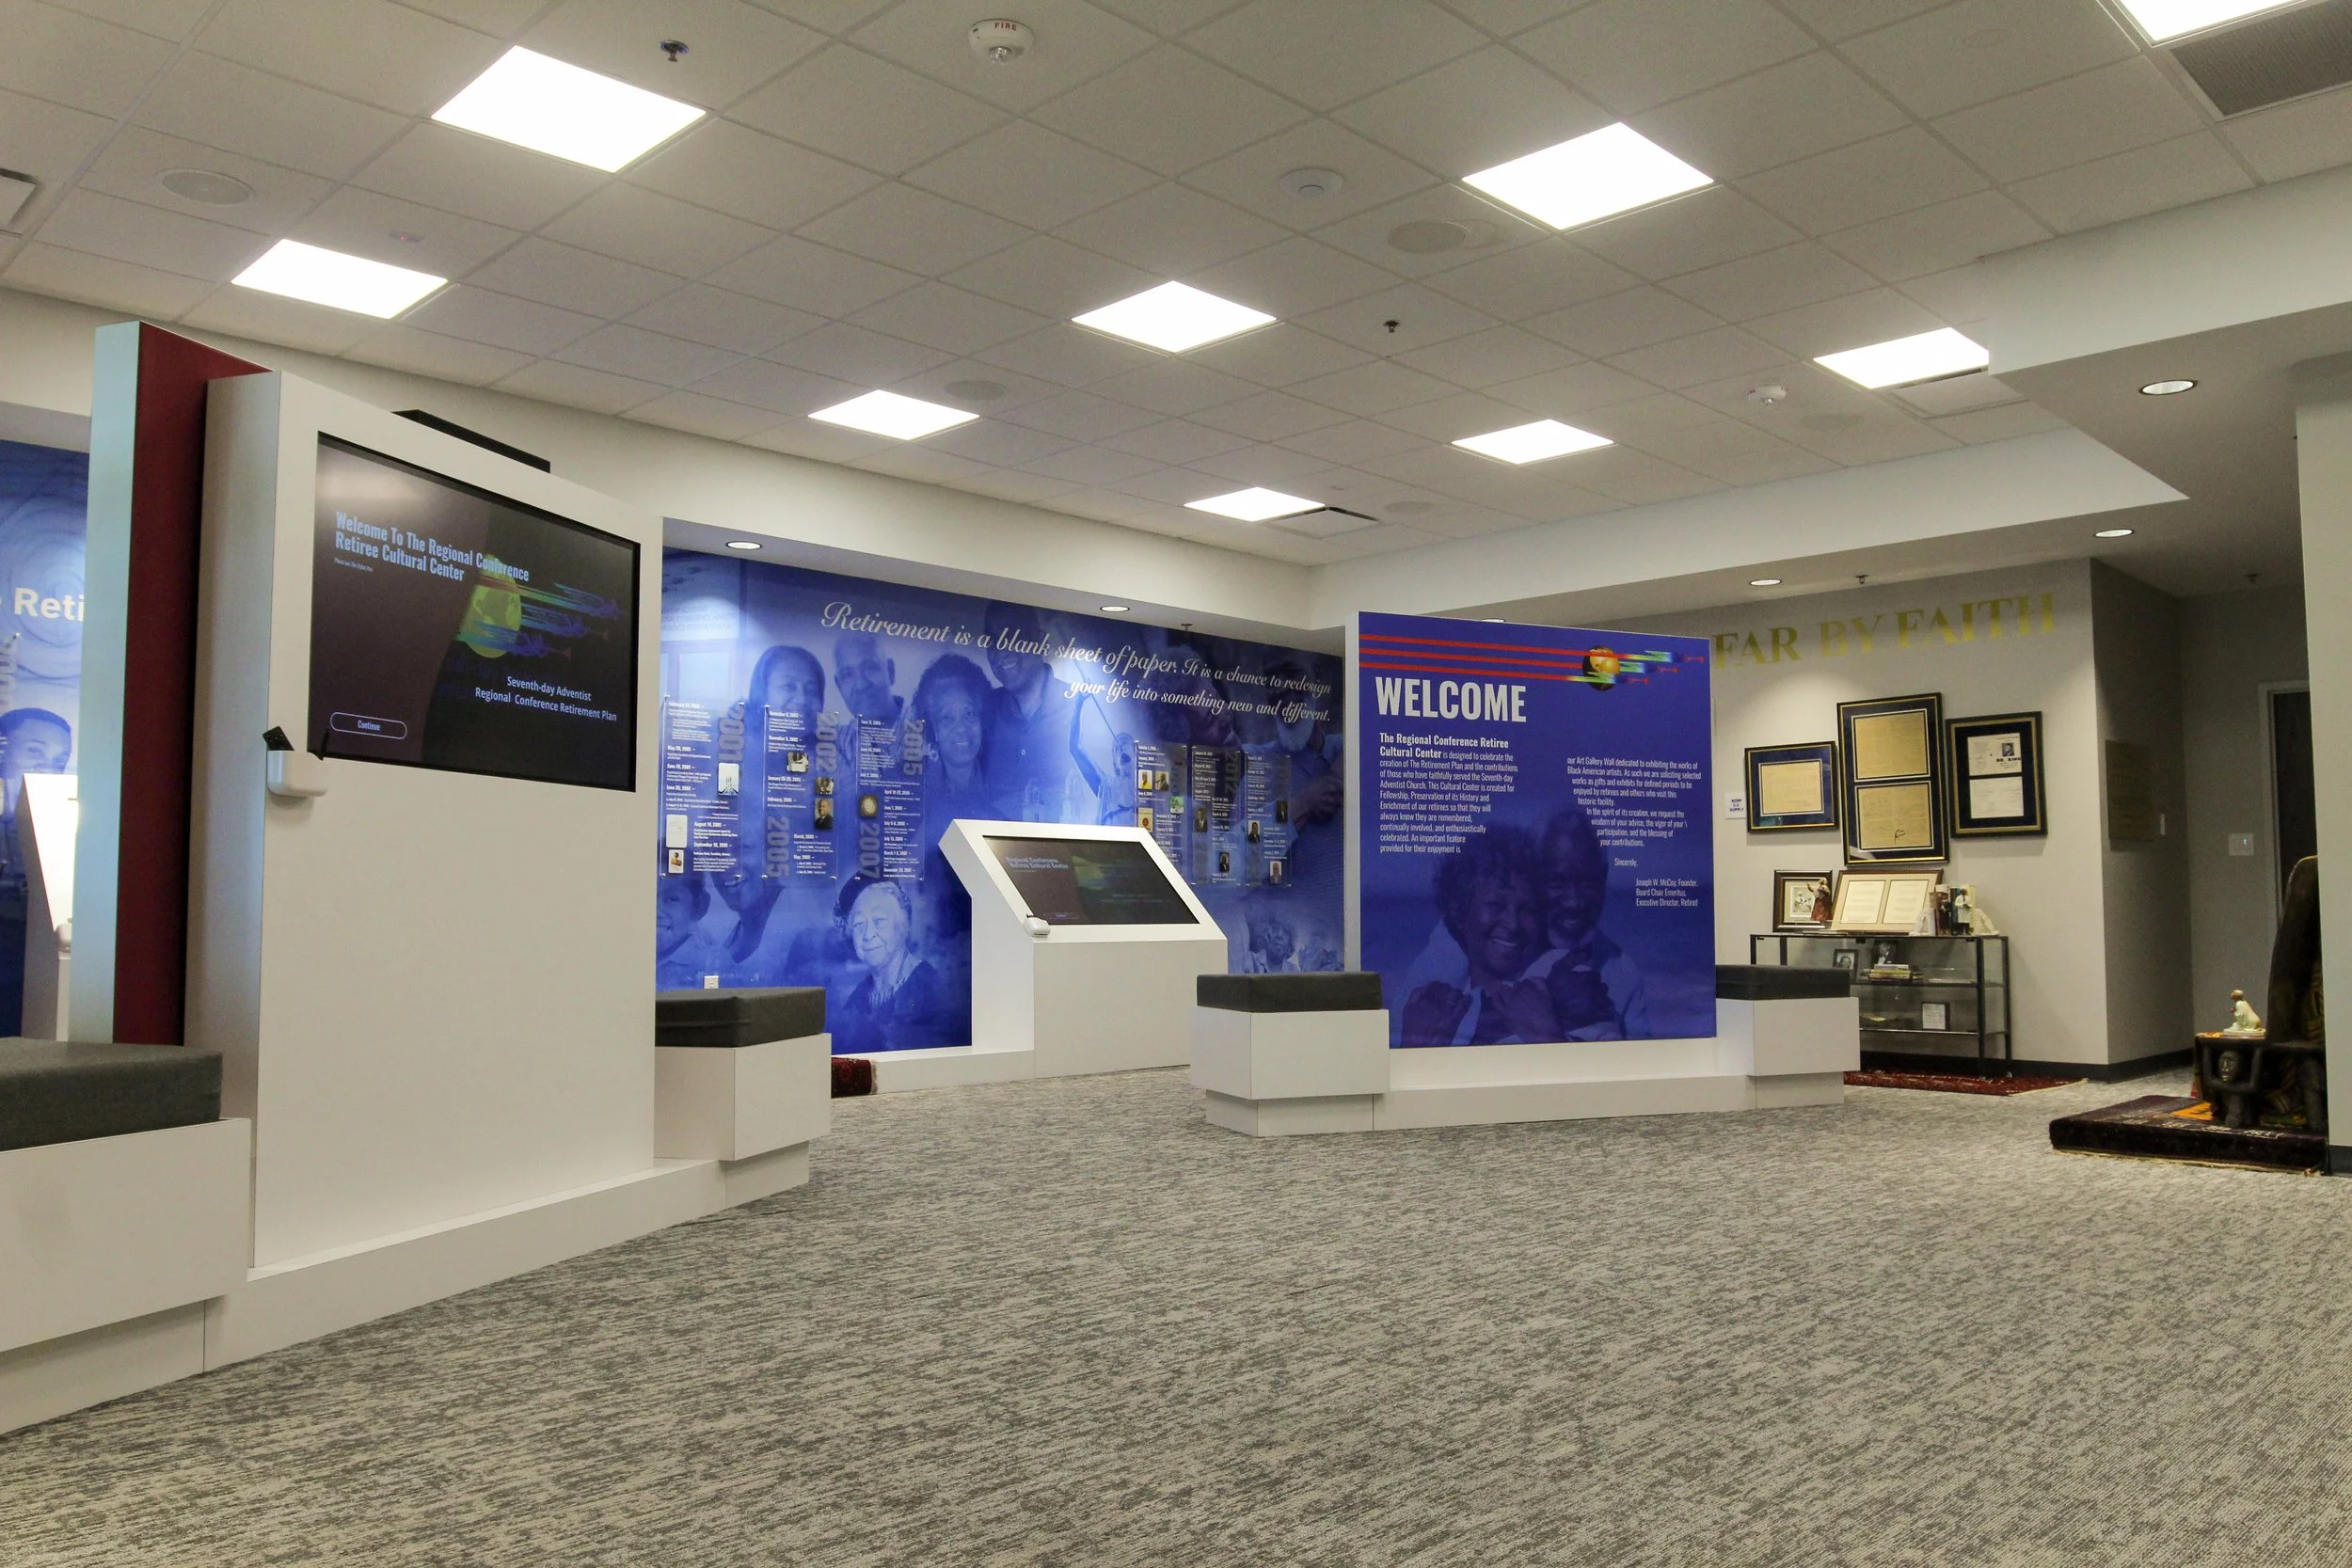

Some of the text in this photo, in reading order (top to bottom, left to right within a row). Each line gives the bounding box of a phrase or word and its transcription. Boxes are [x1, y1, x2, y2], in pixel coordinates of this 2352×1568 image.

[993, 23, 1017, 31] FIRE
[336, 512, 530, 581] Welcome To The Regional Conference
[335, 531, 379, 558] Retiree
[382, 546, 426, 571] Cultural
[429, 558, 465, 581] Center
[1712, 592, 2057, 669] FAR BY FAITH
[821, 601, 951, 642] Retirement
[954, 626, 973, 645] is
[977, 635, 993, 648] a
[996, 627, 1051, 656] blank
[1055, 637, 1102, 663] sheet
[1103, 645, 1131, 673] of
[1182, 658, 1200, 676] It
[1201, 664, 1211, 678] is
[1215, 668, 1223, 680] a
[1226, 665, 1267, 686] chance
[1270, 674, 1281, 687] to
[1283, 673, 1331, 698] redesign
[507, 676, 592, 702] Seventh-day Adventist
[475, 687, 617, 721] Regional Conference Retirement Plan
[1064, 678, 1330, 723] your life into something new and different.
[1375, 676, 1526, 722] WELCOME
[358, 720, 381, 731] Continue
[1380, 732, 1508, 749] The Regional Conference Retiree
[1380, 746, 1412, 757] Cultural
[1415, 748, 1441, 758] Center
[1449, 752, 1471, 761] designed
[1480, 752, 1503, 761] celebrate
[1403, 760, 1408, 768] of
[1421, 761, 1450, 769] Retirement
[1452, 762, 1463, 770] Plan
[1465, 762, 1473, 770] and
[1485, 763, 1518, 771] contributions
[1380, 769, 1385, 778] of
[1387, 769, 1401, 778] those
[1403, 770, 1414, 779] who
[1415, 770, 1427, 779] have
[1429, 771, 1452, 781] faithfully
[1454, 771, 1470, 781] served
[1482, 772, 1513, 783] Seventh-day
[1380, 780, 1405, 789] Adventist
[1429, 782, 1438, 790] This
[1440, 782, 1461, 790] Cultural
[1462, 782, 1479, 791] Center
[1481, 783, 1485, 791] is
[1486, 783, 1505, 792] created
[1411, 791, 1443, 800] Preservation
[1445, 792, 1450, 800] of
[1460, 793, 1478, 802] History
[1480, 793, 1489, 801] and
[1380, 801, 1410, 810] Enrichment
[1429, 802, 1449, 811] retirees
[1457, 803, 1468, 812] that
[1470, 803, 1480, 813] they
[1482, 804, 1490, 813] will
[1380, 812, 1398, 821] always
[1416, 813, 1426, 822] they
[1380, 823, 1409, 832] continually
[1446, 824, 1486, 833] enthusiastically
[1411, 833, 1418, 842] An
[1420, 834, 1445, 844] important
[1447, 834, 1466, 843] feature
[1380, 845, 1403, 853] provided
[1427, 845, 1454, 854] enjoyment
[1456, 845, 1460, 853] is
